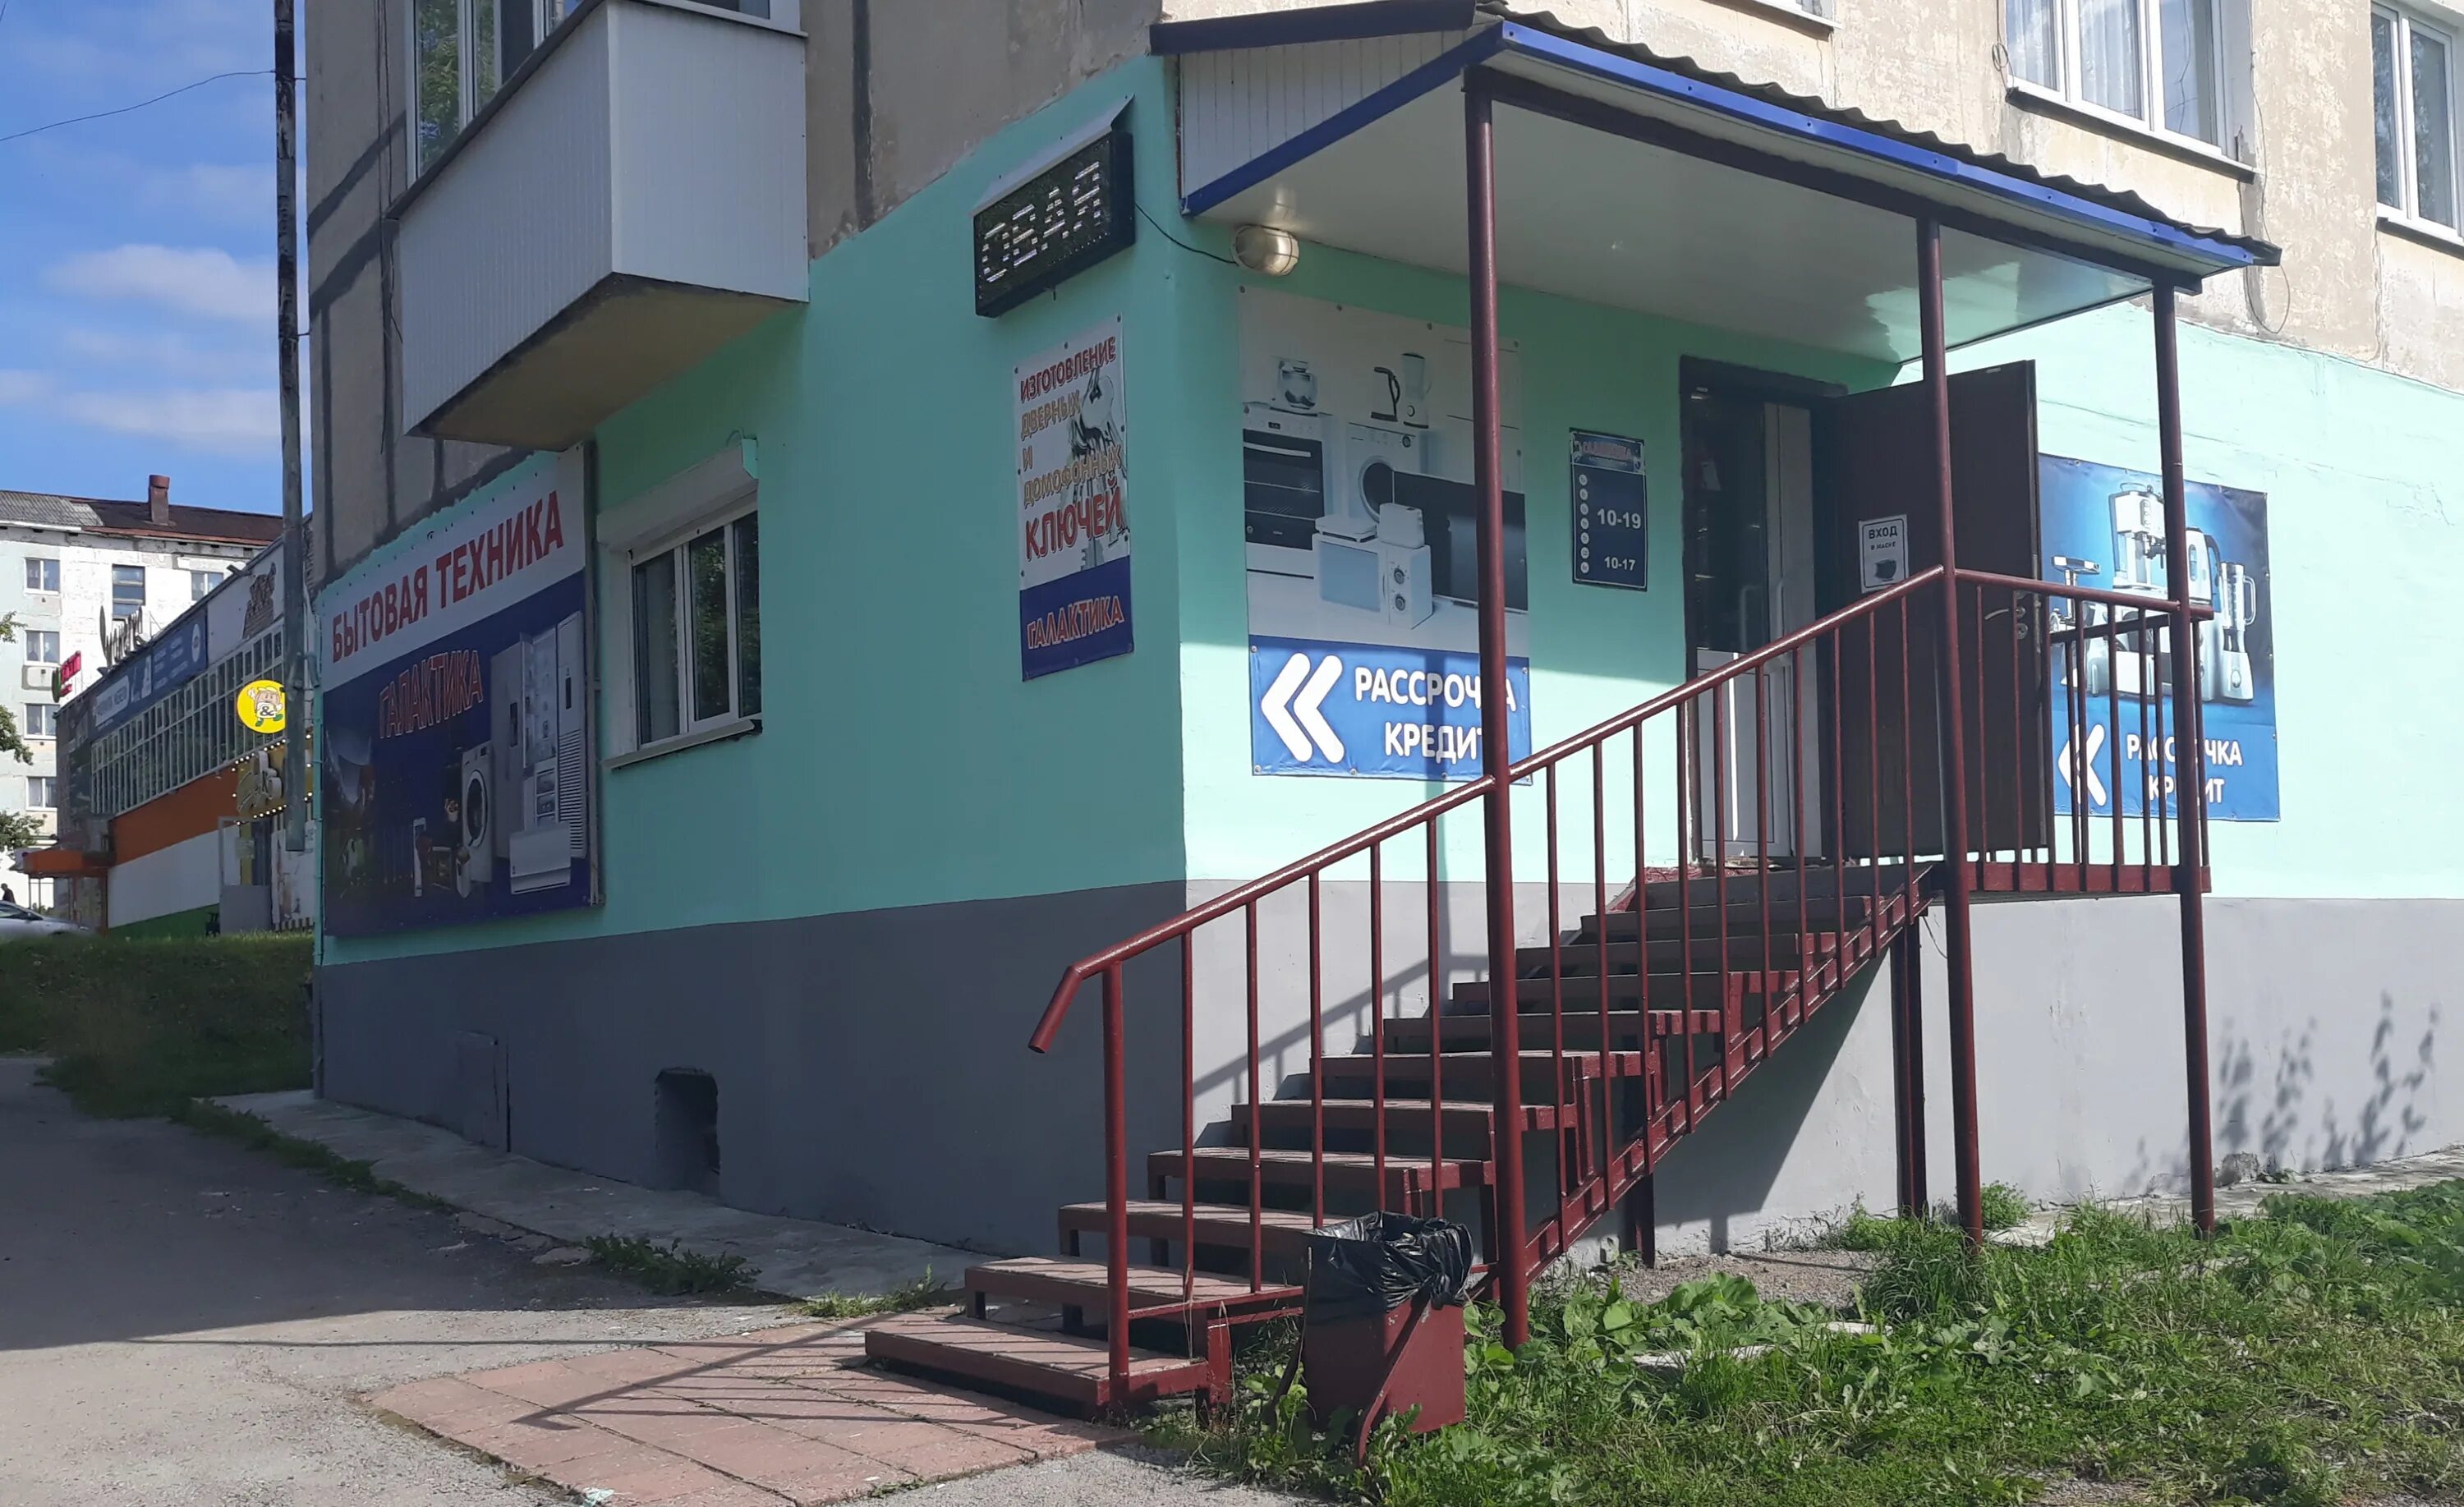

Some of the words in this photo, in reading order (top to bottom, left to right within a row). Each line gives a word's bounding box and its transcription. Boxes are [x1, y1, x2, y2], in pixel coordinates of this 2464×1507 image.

[1020, 336, 1117, 403] ИЗГОТОВЛЕНИЕ
[1021, 390, 1082, 441] ДВЕРНЫХ
[1023, 445, 1033, 472] И
[1023, 443, 1122, 509] ДОМОФОННЫХ
[1025, 474, 1123, 562] КЛЮЧЕЙ
[1597, 508, 1642, 530] 10-19
[1869, 526, 1898, 540] ВХОД
[333, 565, 428, 664] БЫТОВАЯ
[436, 490, 564, 609] ТЕХНИКА
[1604, 556, 1636, 572] 10-17
[1027, 595, 1125, 650] ГАЛАКТИКА
[379, 650, 484, 739] ГАЛАКТИКА
[1355, 667, 1517, 712] РАССРОЧА
[1385, 722, 1483, 765] КРЕДИ
[2126, 733, 2243, 766] РСЧКА
[2148, 774, 2225, 807] КРИТ
